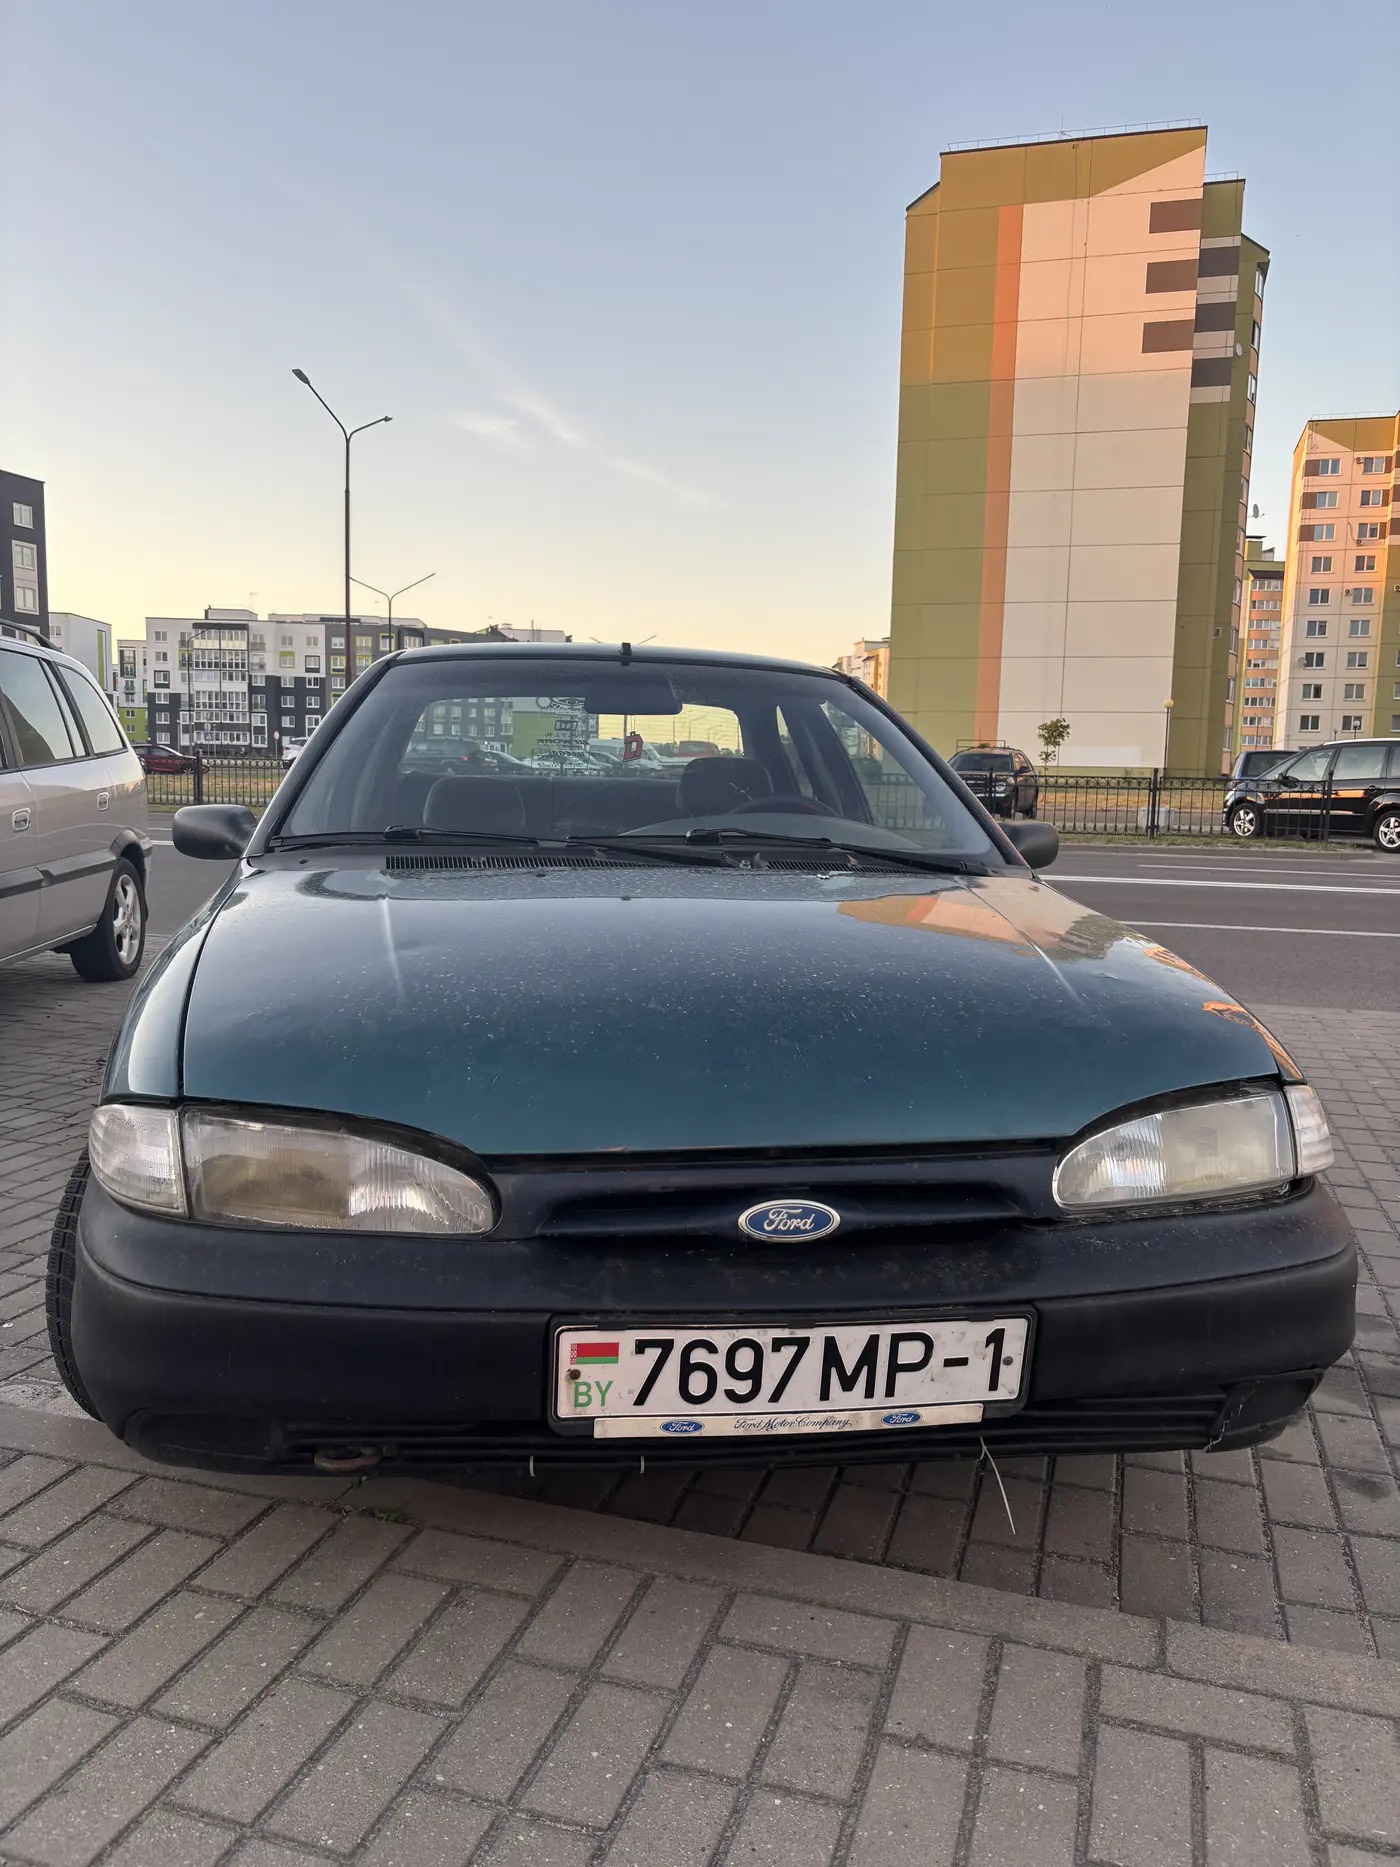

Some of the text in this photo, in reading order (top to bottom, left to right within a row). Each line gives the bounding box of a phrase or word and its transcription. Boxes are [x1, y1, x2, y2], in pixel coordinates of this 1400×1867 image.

[763, 1208, 816, 1232] Ford
[574, 1380, 614, 1408] BY
[669, 1420, 696, 1432] Ford
[734, 1415, 853, 1431] Ford Motor Company
[889, 1413, 914, 1424] Ford
